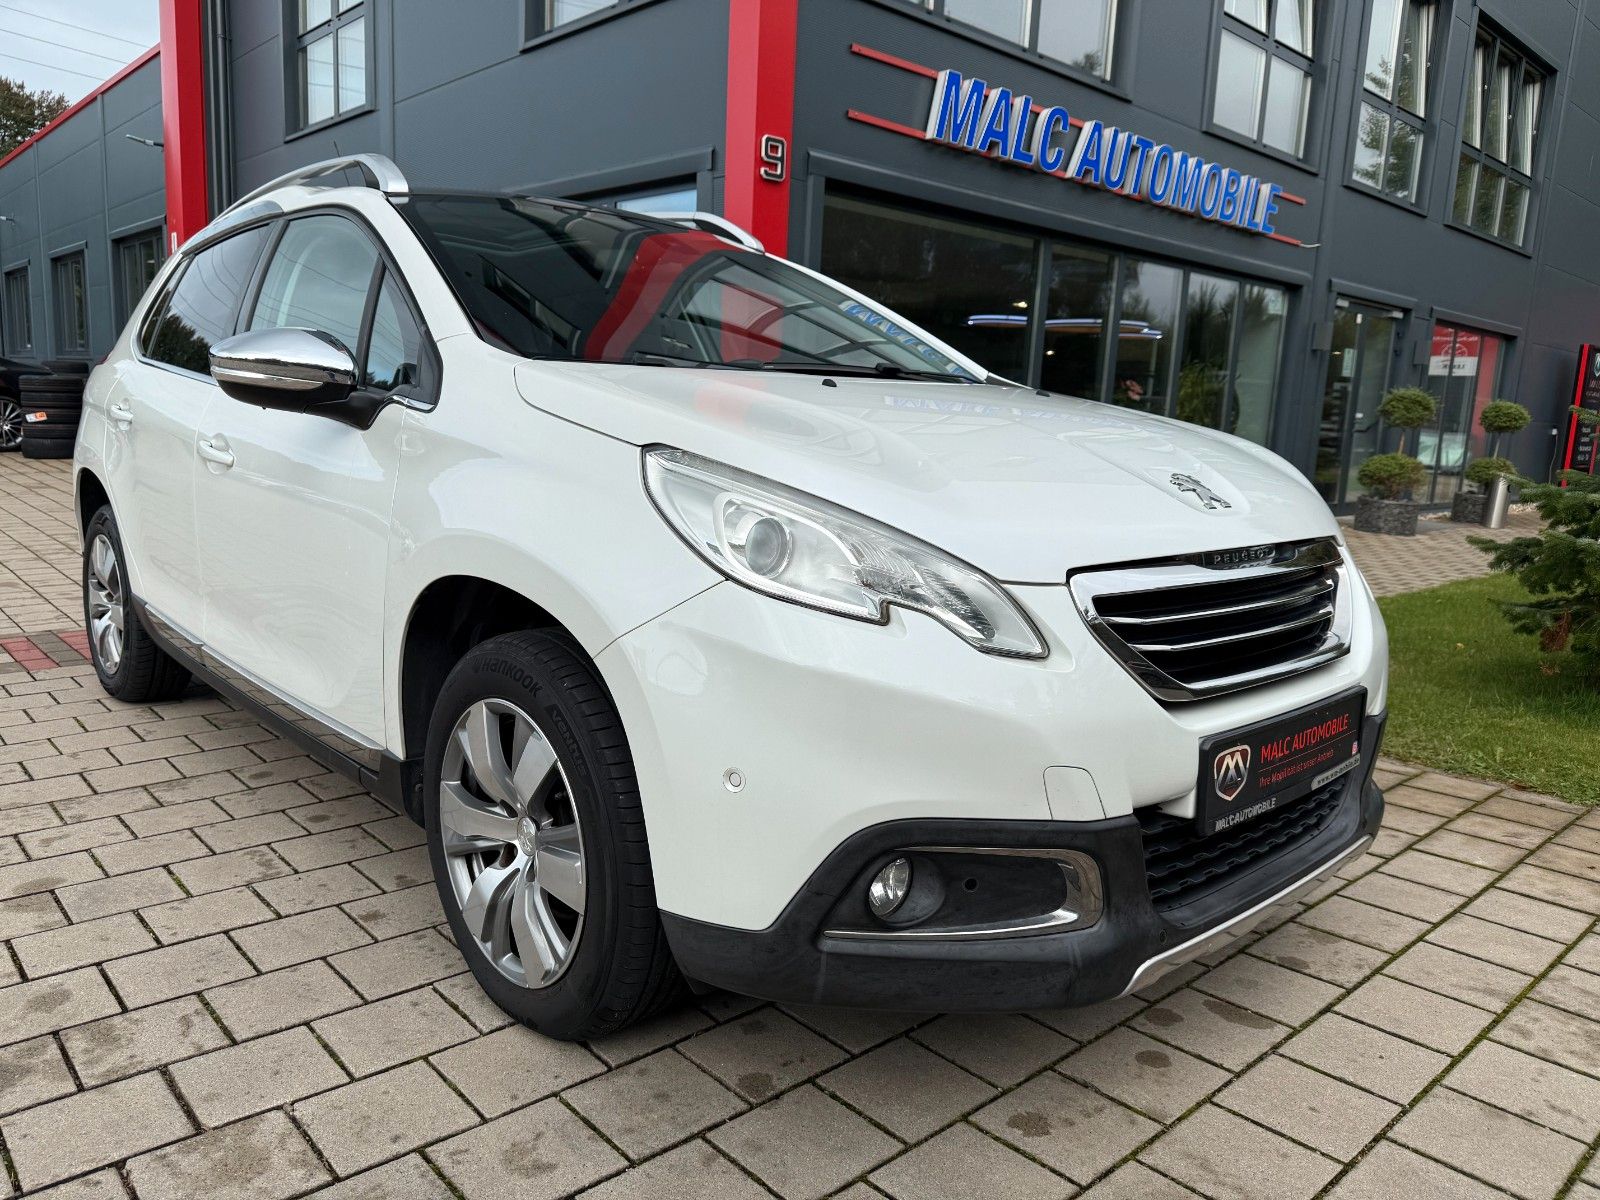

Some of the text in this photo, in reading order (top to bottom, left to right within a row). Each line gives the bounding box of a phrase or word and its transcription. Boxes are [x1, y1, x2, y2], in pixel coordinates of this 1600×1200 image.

[760, 134, 787, 182] 9
[928, 69, 1282, 234] MALC AUTOMOBILE
[1213, 547, 1271, 565] PEUGEOT
[1260, 714, 1349, 763] MALC AUTOMOBILE
